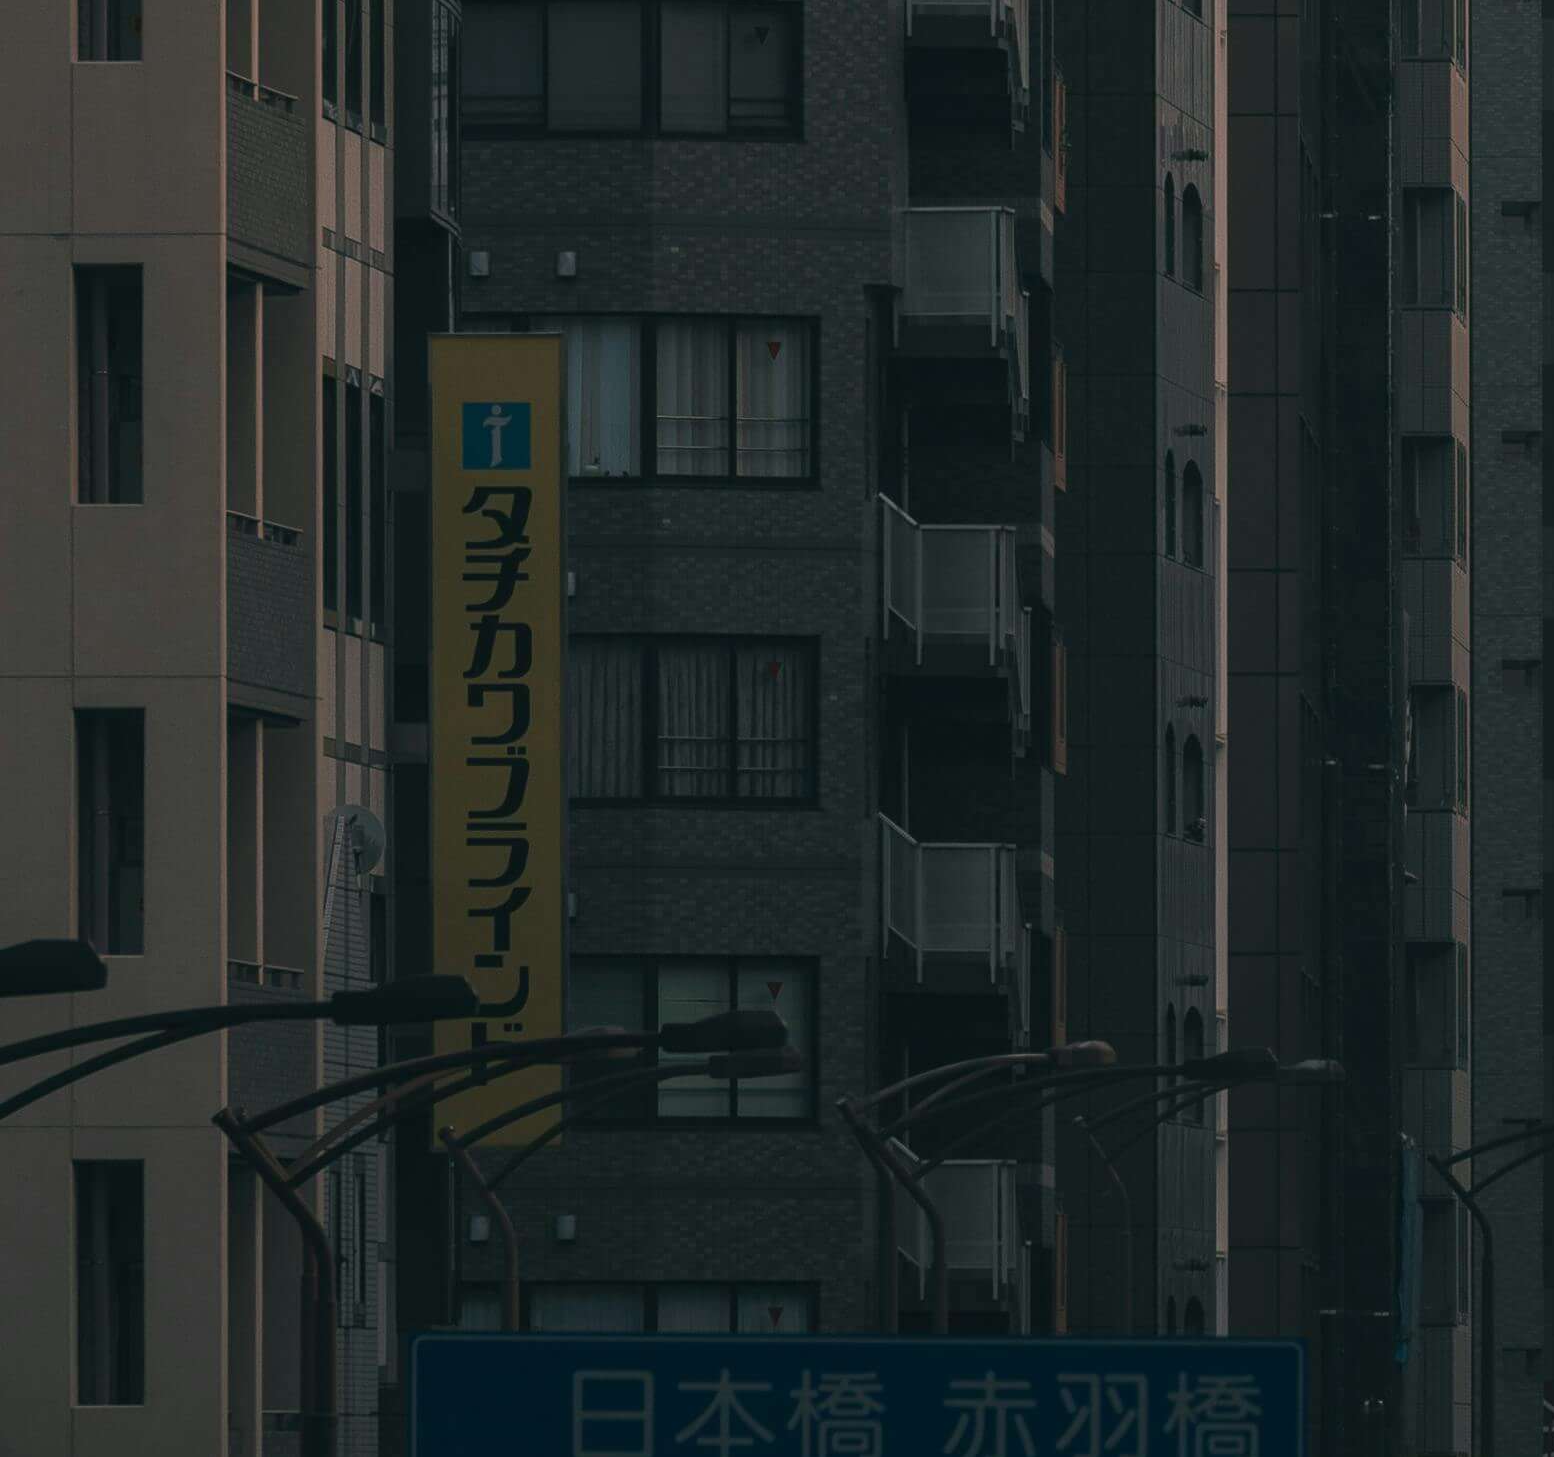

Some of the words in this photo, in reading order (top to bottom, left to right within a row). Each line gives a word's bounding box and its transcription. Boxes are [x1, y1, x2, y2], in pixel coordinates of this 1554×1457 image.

[462, 485, 533, 1088] タチカワブラインド
